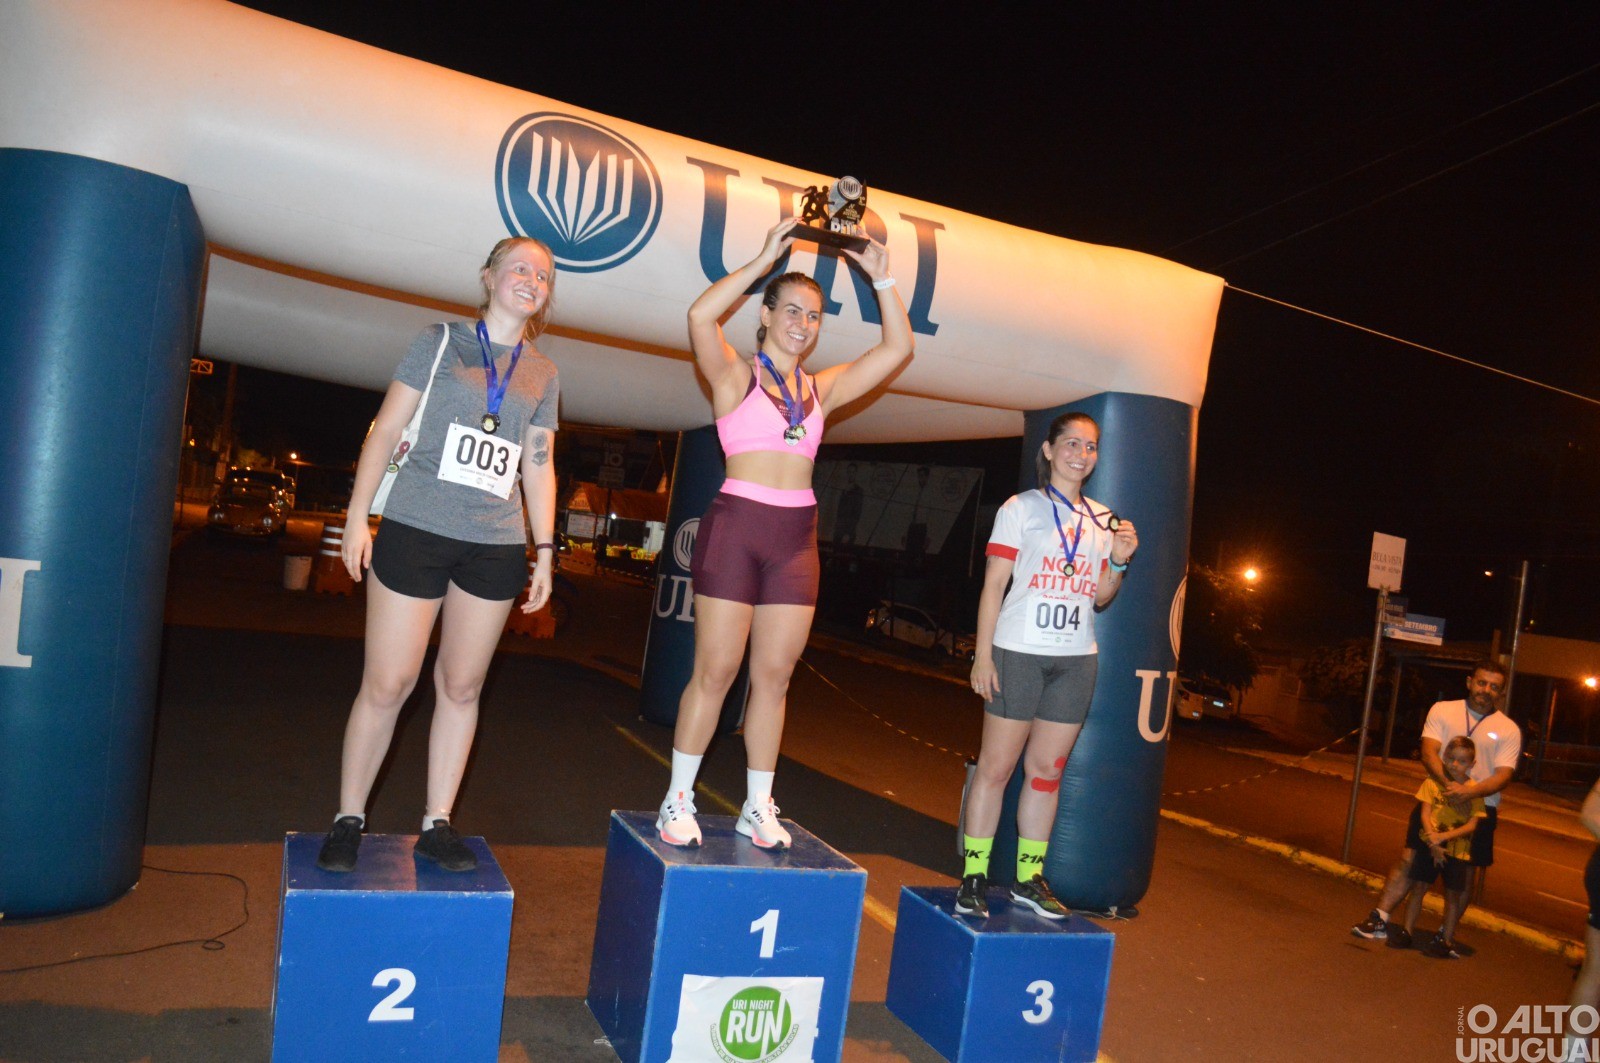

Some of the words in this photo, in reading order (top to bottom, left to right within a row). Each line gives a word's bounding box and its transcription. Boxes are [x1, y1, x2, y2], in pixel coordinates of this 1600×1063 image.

[686, 156, 945, 336] URI
[456, 434, 509, 477] 003
[1028, 573, 1097, 598] ATITUDE
[1042, 556, 1093, 577] NOVA
[1036, 602, 1080, 631] 004
[1404, 621, 1438, 633] SETEMBRO
[750, 909, 780, 958] 1
[368, 967, 416, 1021] 2
[732, 999, 746, 1010] URI
[749, 999, 774, 1010] NIGHT
[1022, 979, 1054, 1024] 3
[726, 996, 785, 1052] RUN
